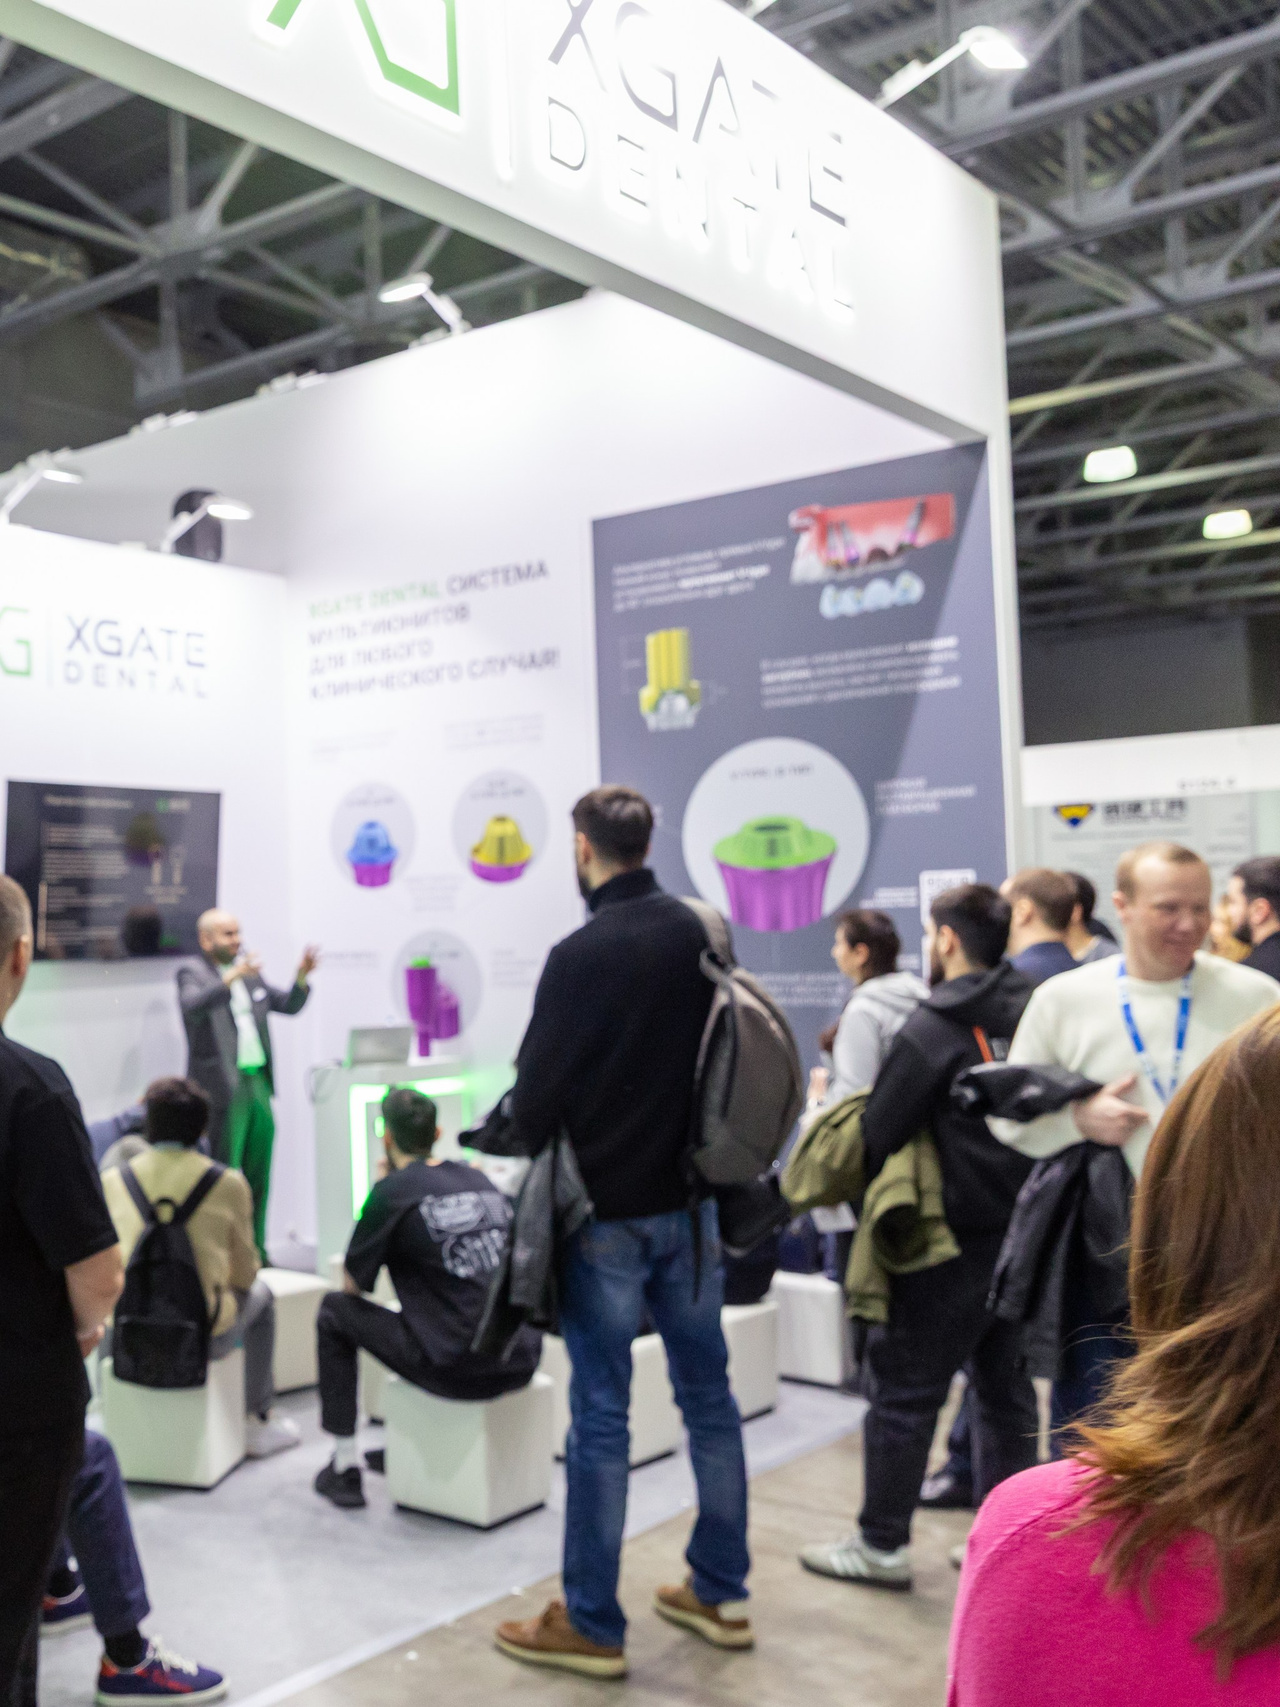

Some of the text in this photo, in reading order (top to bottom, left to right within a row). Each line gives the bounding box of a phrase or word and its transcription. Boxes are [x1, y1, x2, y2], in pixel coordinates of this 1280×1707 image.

[447, 560, 548, 595] СИСТЕМА
[66, 614, 207, 669] XGATE
[65, 660, 207, 699] DENTAL
